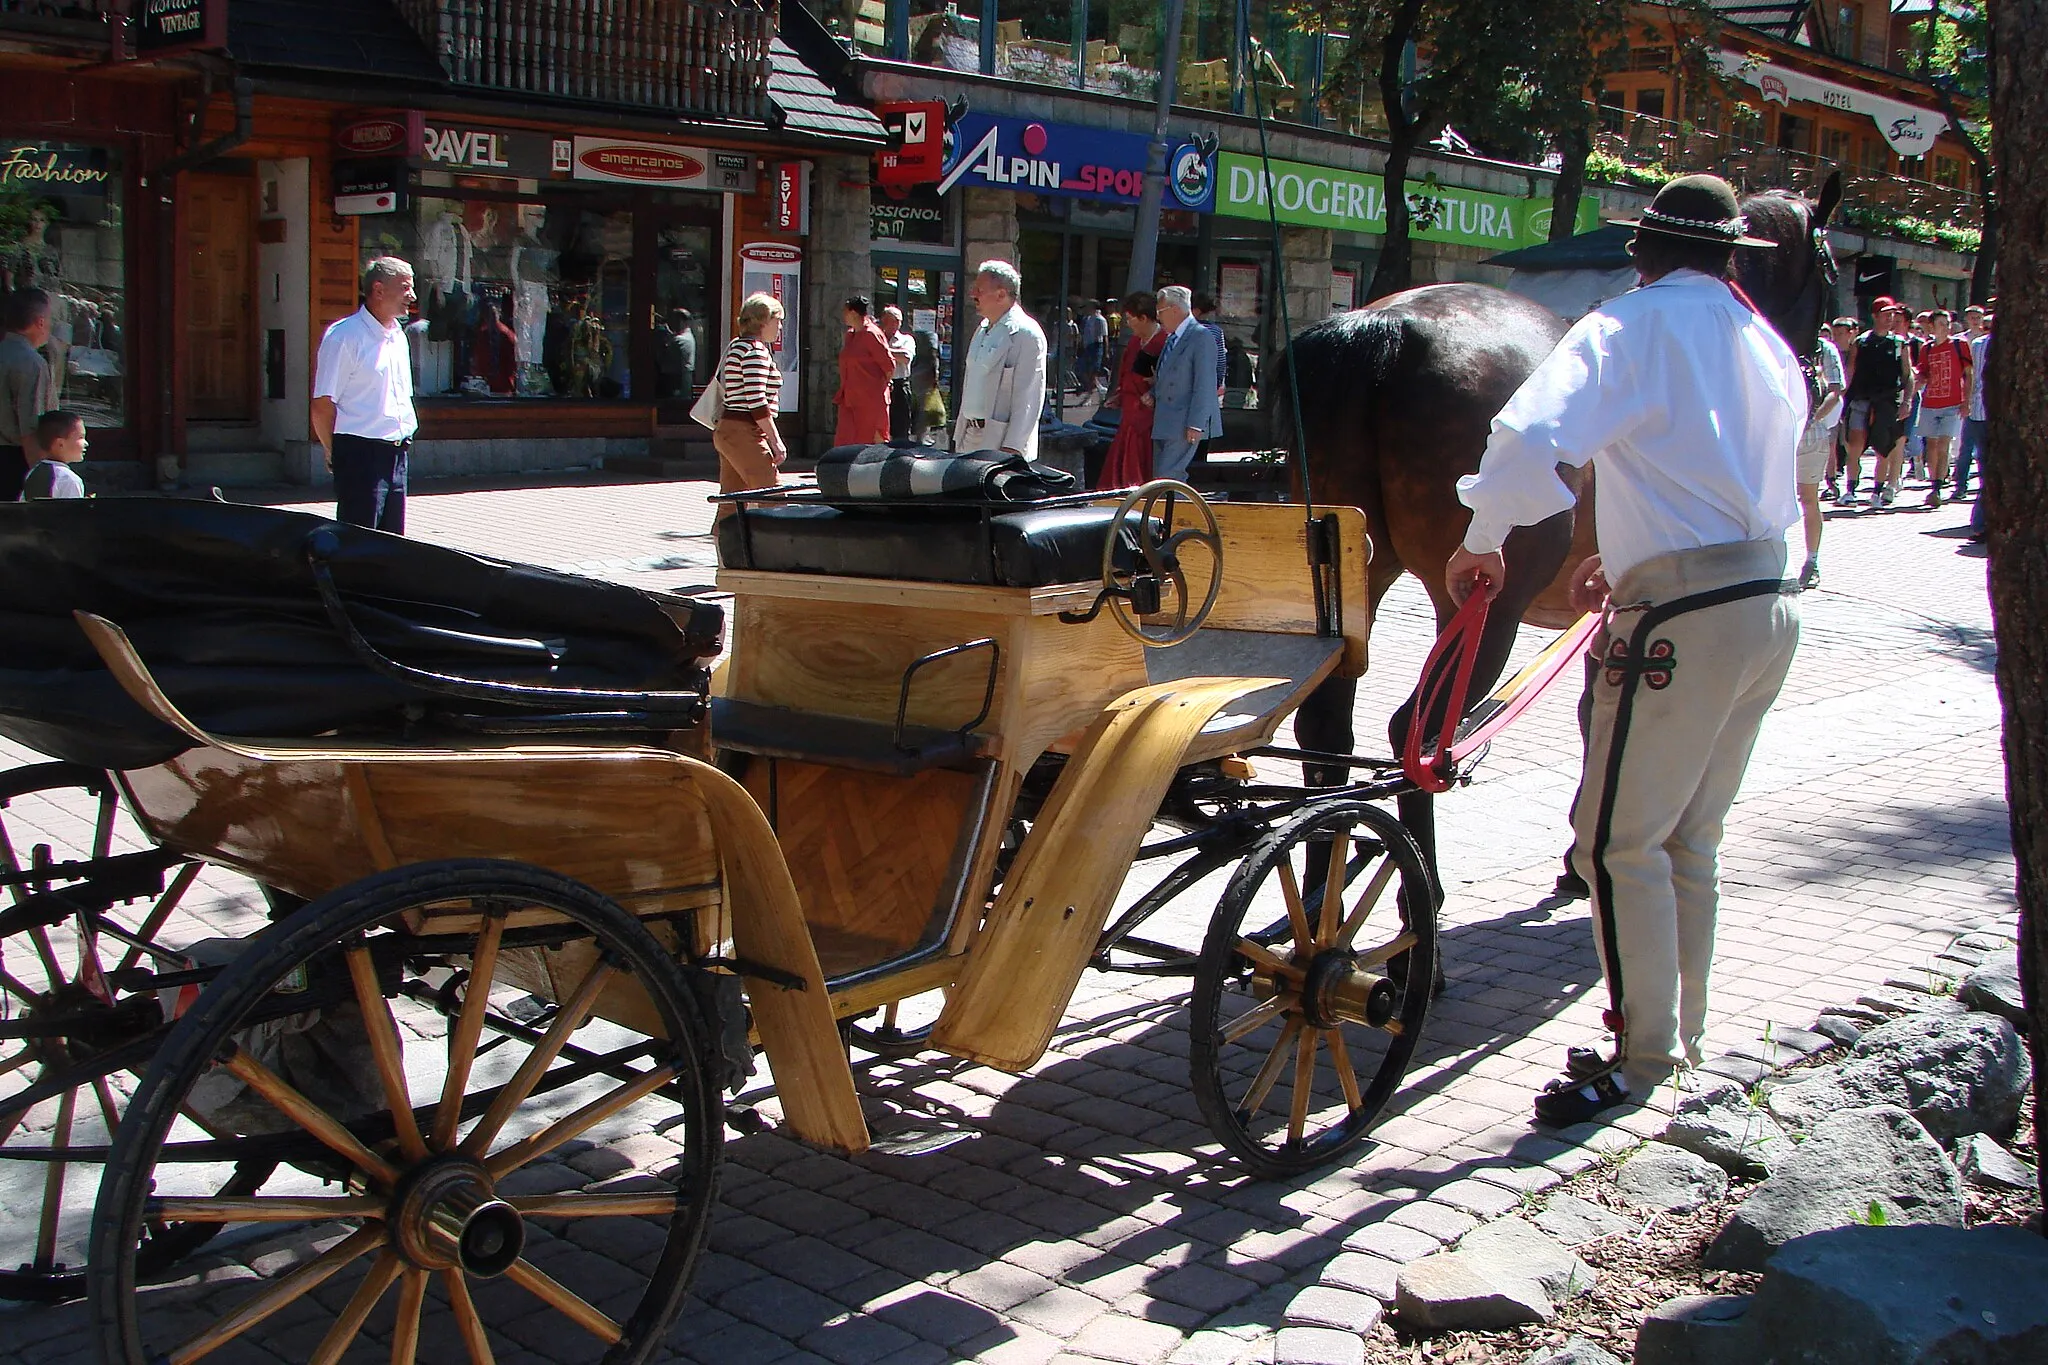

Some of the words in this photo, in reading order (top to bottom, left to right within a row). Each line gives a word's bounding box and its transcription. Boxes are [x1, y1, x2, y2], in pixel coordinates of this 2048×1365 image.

[160, 11, 200, 34] VINTAGE
[1823, 90, 1852, 109] HOTEL
[1, 146, 108, 185] Fashion
[600, 152, 684, 169] americanos
[869, 205, 942, 221] OSSIGNOL
